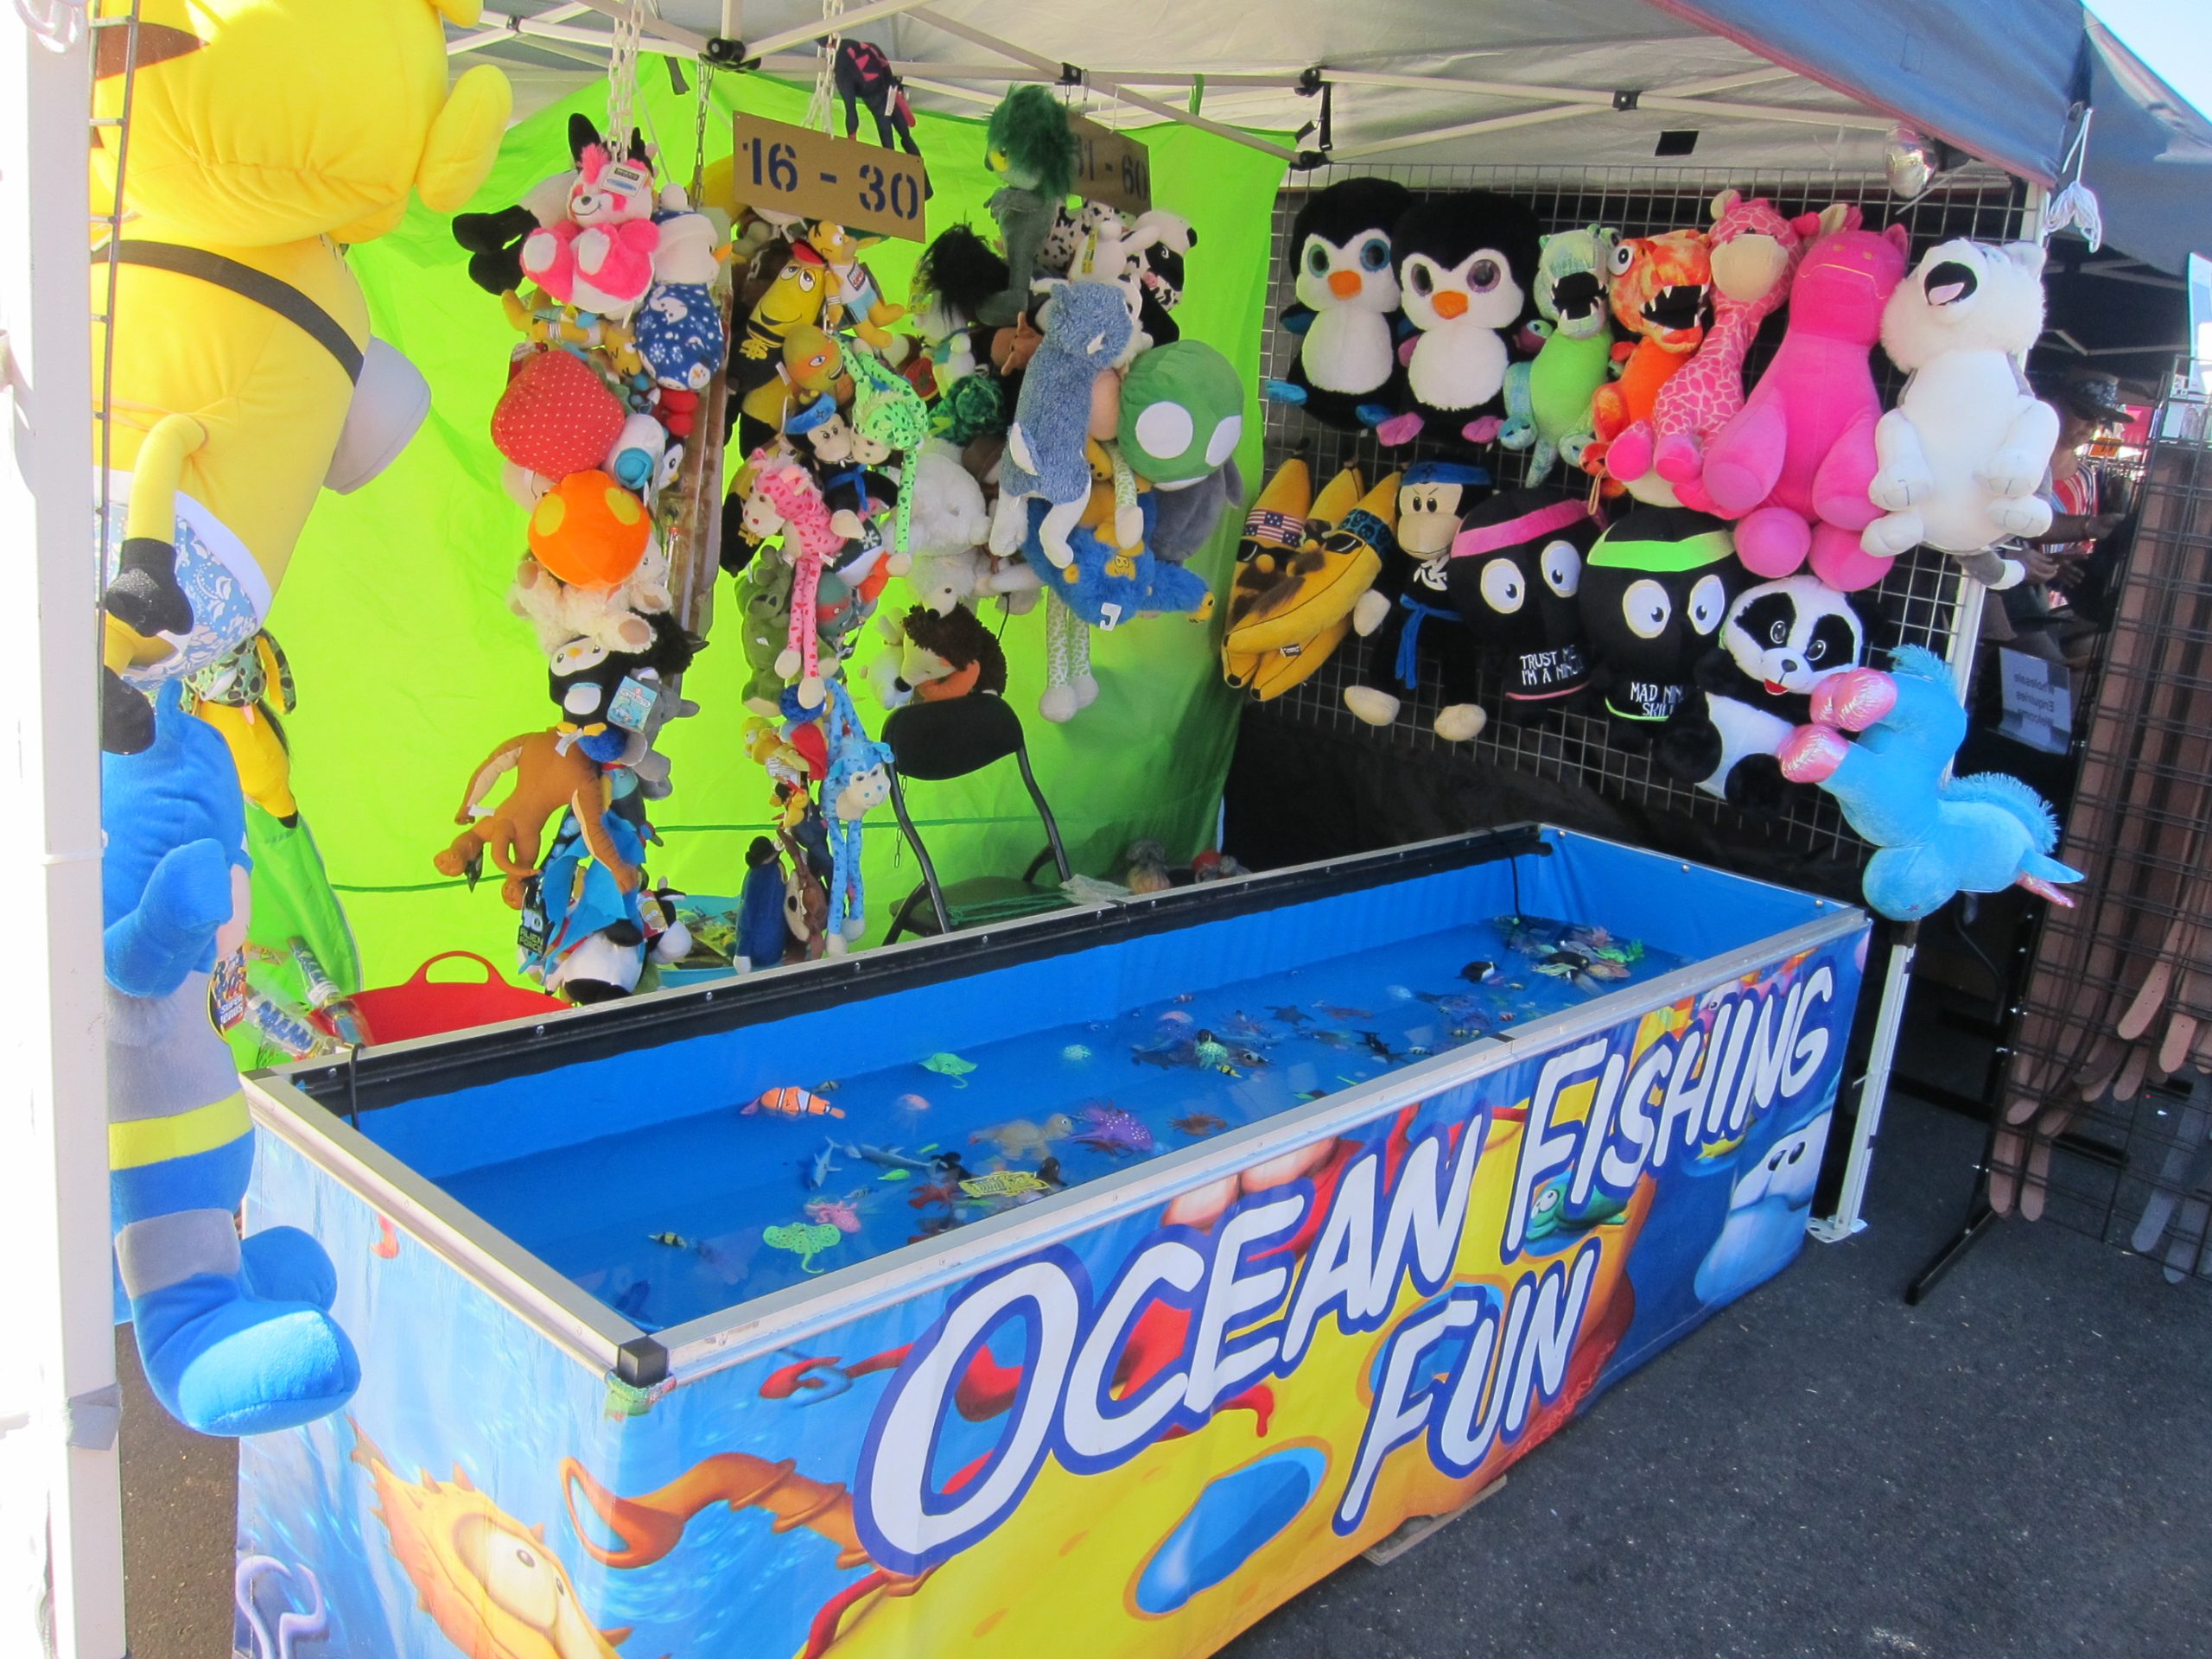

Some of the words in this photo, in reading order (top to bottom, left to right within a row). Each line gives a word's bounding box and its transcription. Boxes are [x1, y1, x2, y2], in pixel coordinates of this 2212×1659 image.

[742, 137, 798, 192] 16
[859, 163, 918, 220] 30
[1122, 154, 1148, 201] 60
[1519, 651, 1558, 671] TRUST
[1522, 668, 1538, 685] I'M
[1542, 667, 1553, 683] A
[1630, 681, 1658, 702] MAD
[868, 1110, 1488, 1556] OCEAN
[1505, 965, 1834, 1252] FISHING
[1338, 1246, 1592, 1524] FUN
